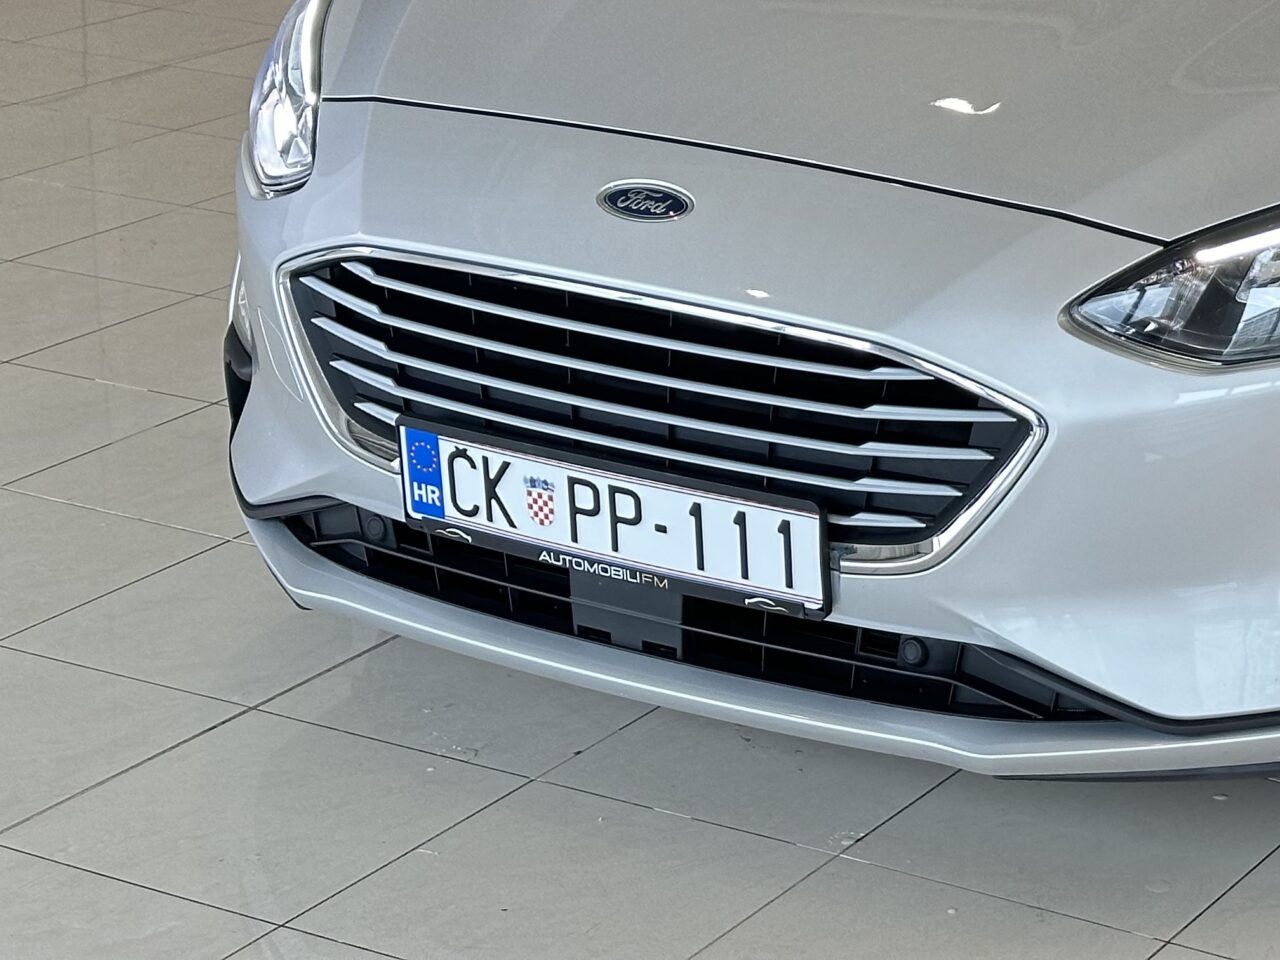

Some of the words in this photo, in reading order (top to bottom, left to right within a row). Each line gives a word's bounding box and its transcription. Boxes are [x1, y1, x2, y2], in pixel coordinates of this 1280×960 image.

[616, 188, 673, 215] Ford
[412, 481, 441, 507] HR
[447, 445, 518, 529] ČK
[566, 475, 794, 589] PP-111
